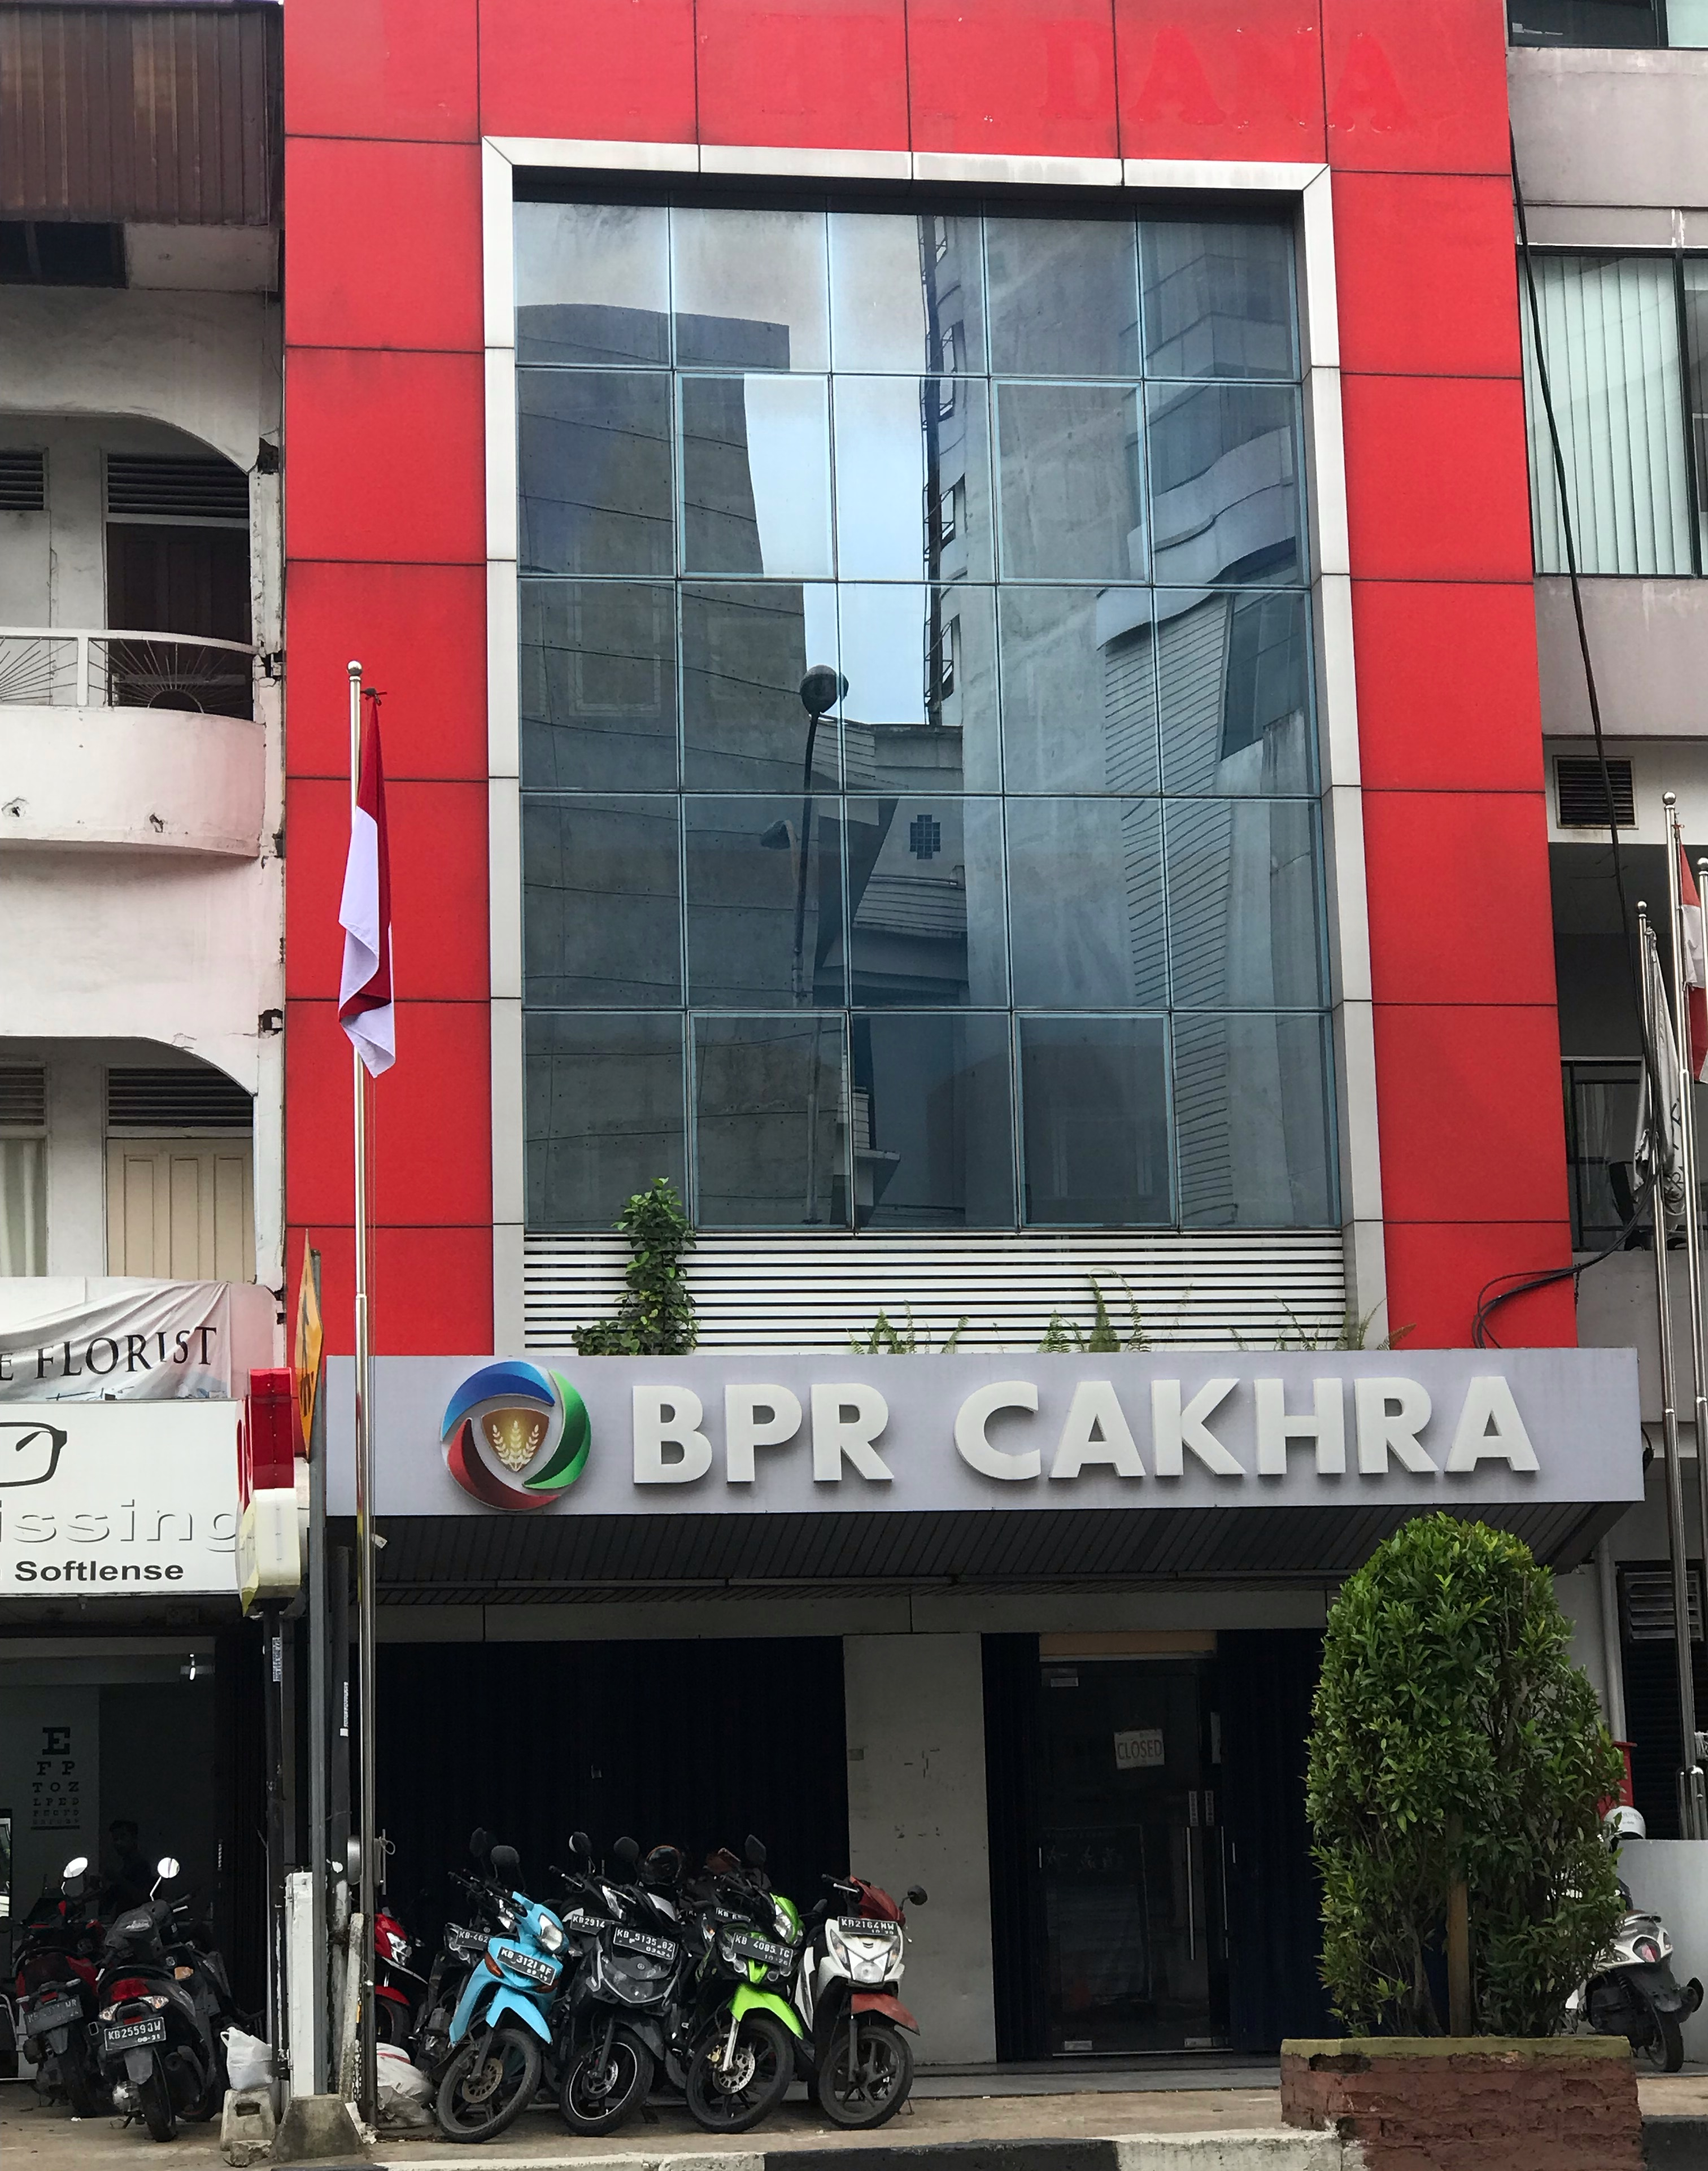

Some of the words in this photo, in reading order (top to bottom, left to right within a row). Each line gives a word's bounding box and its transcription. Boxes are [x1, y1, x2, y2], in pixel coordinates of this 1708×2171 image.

[34, 1326, 217, 1379] FLORIST
[633, 1382, 894, 1484] BPR
[953, 1376, 1541, 1480] CAKHRA
[0, 1499, 236, 1553] ssing
[15, 1560, 184, 1581] Softlense
[42, 1727, 71, 1755] E
[1117, 1740, 1162, 1760] CLOSED
[617, 1929, 629, 1938] KB
[635, 1933, 657, 1946] 5135
[735, 1934, 747, 1945] KB
[501, 1948, 514, 1959] KB
[516, 1955, 538, 1969] 3121
